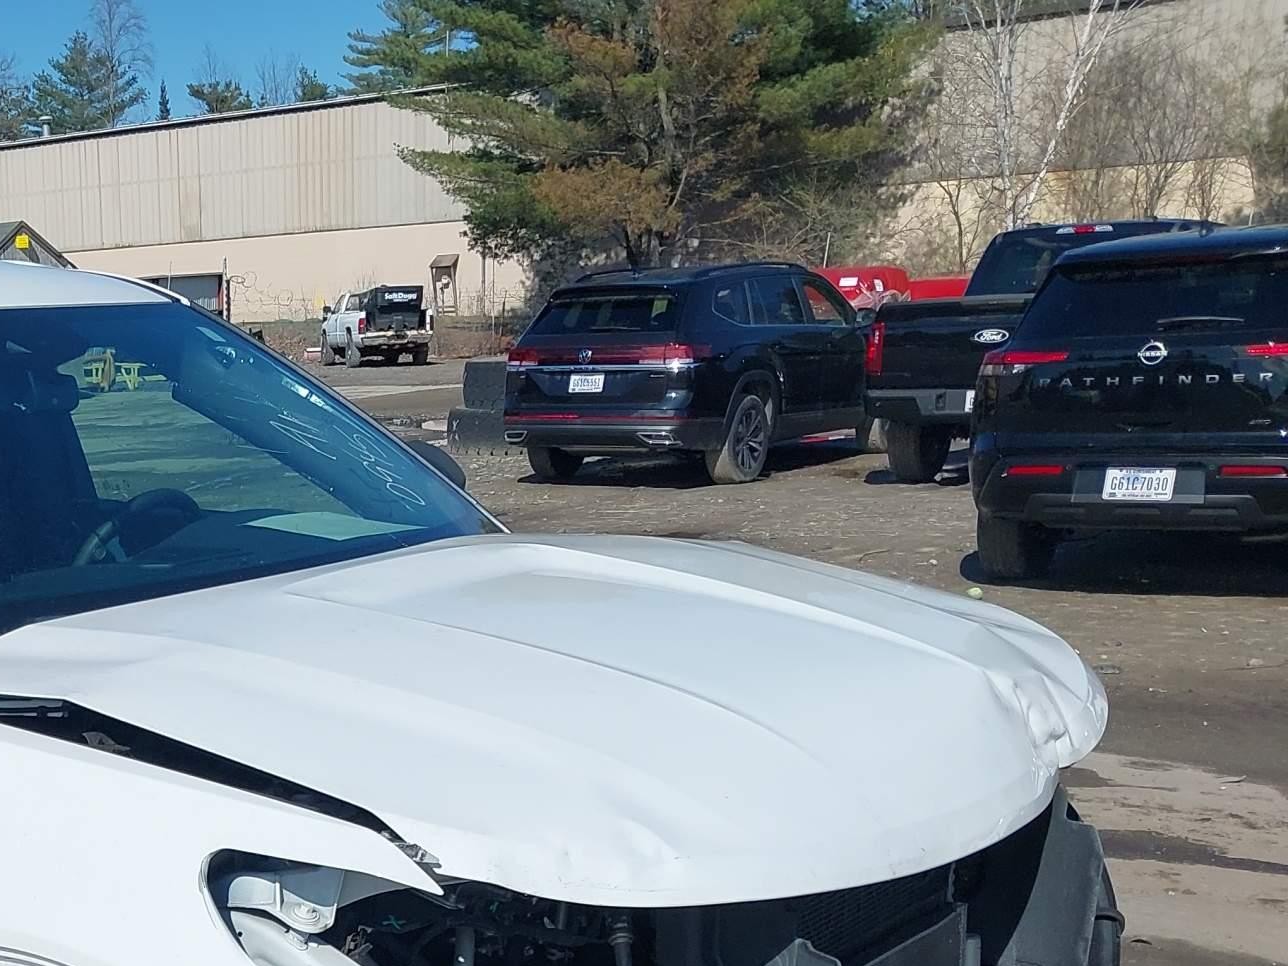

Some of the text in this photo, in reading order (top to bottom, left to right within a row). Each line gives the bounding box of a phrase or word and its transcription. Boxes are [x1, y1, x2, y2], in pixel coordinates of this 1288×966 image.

[977, 330, 1005, 341] Ford
[1039, 372, 1274, 388] PATHFINDER
[1110, 476, 1170, 492] G61C7030
